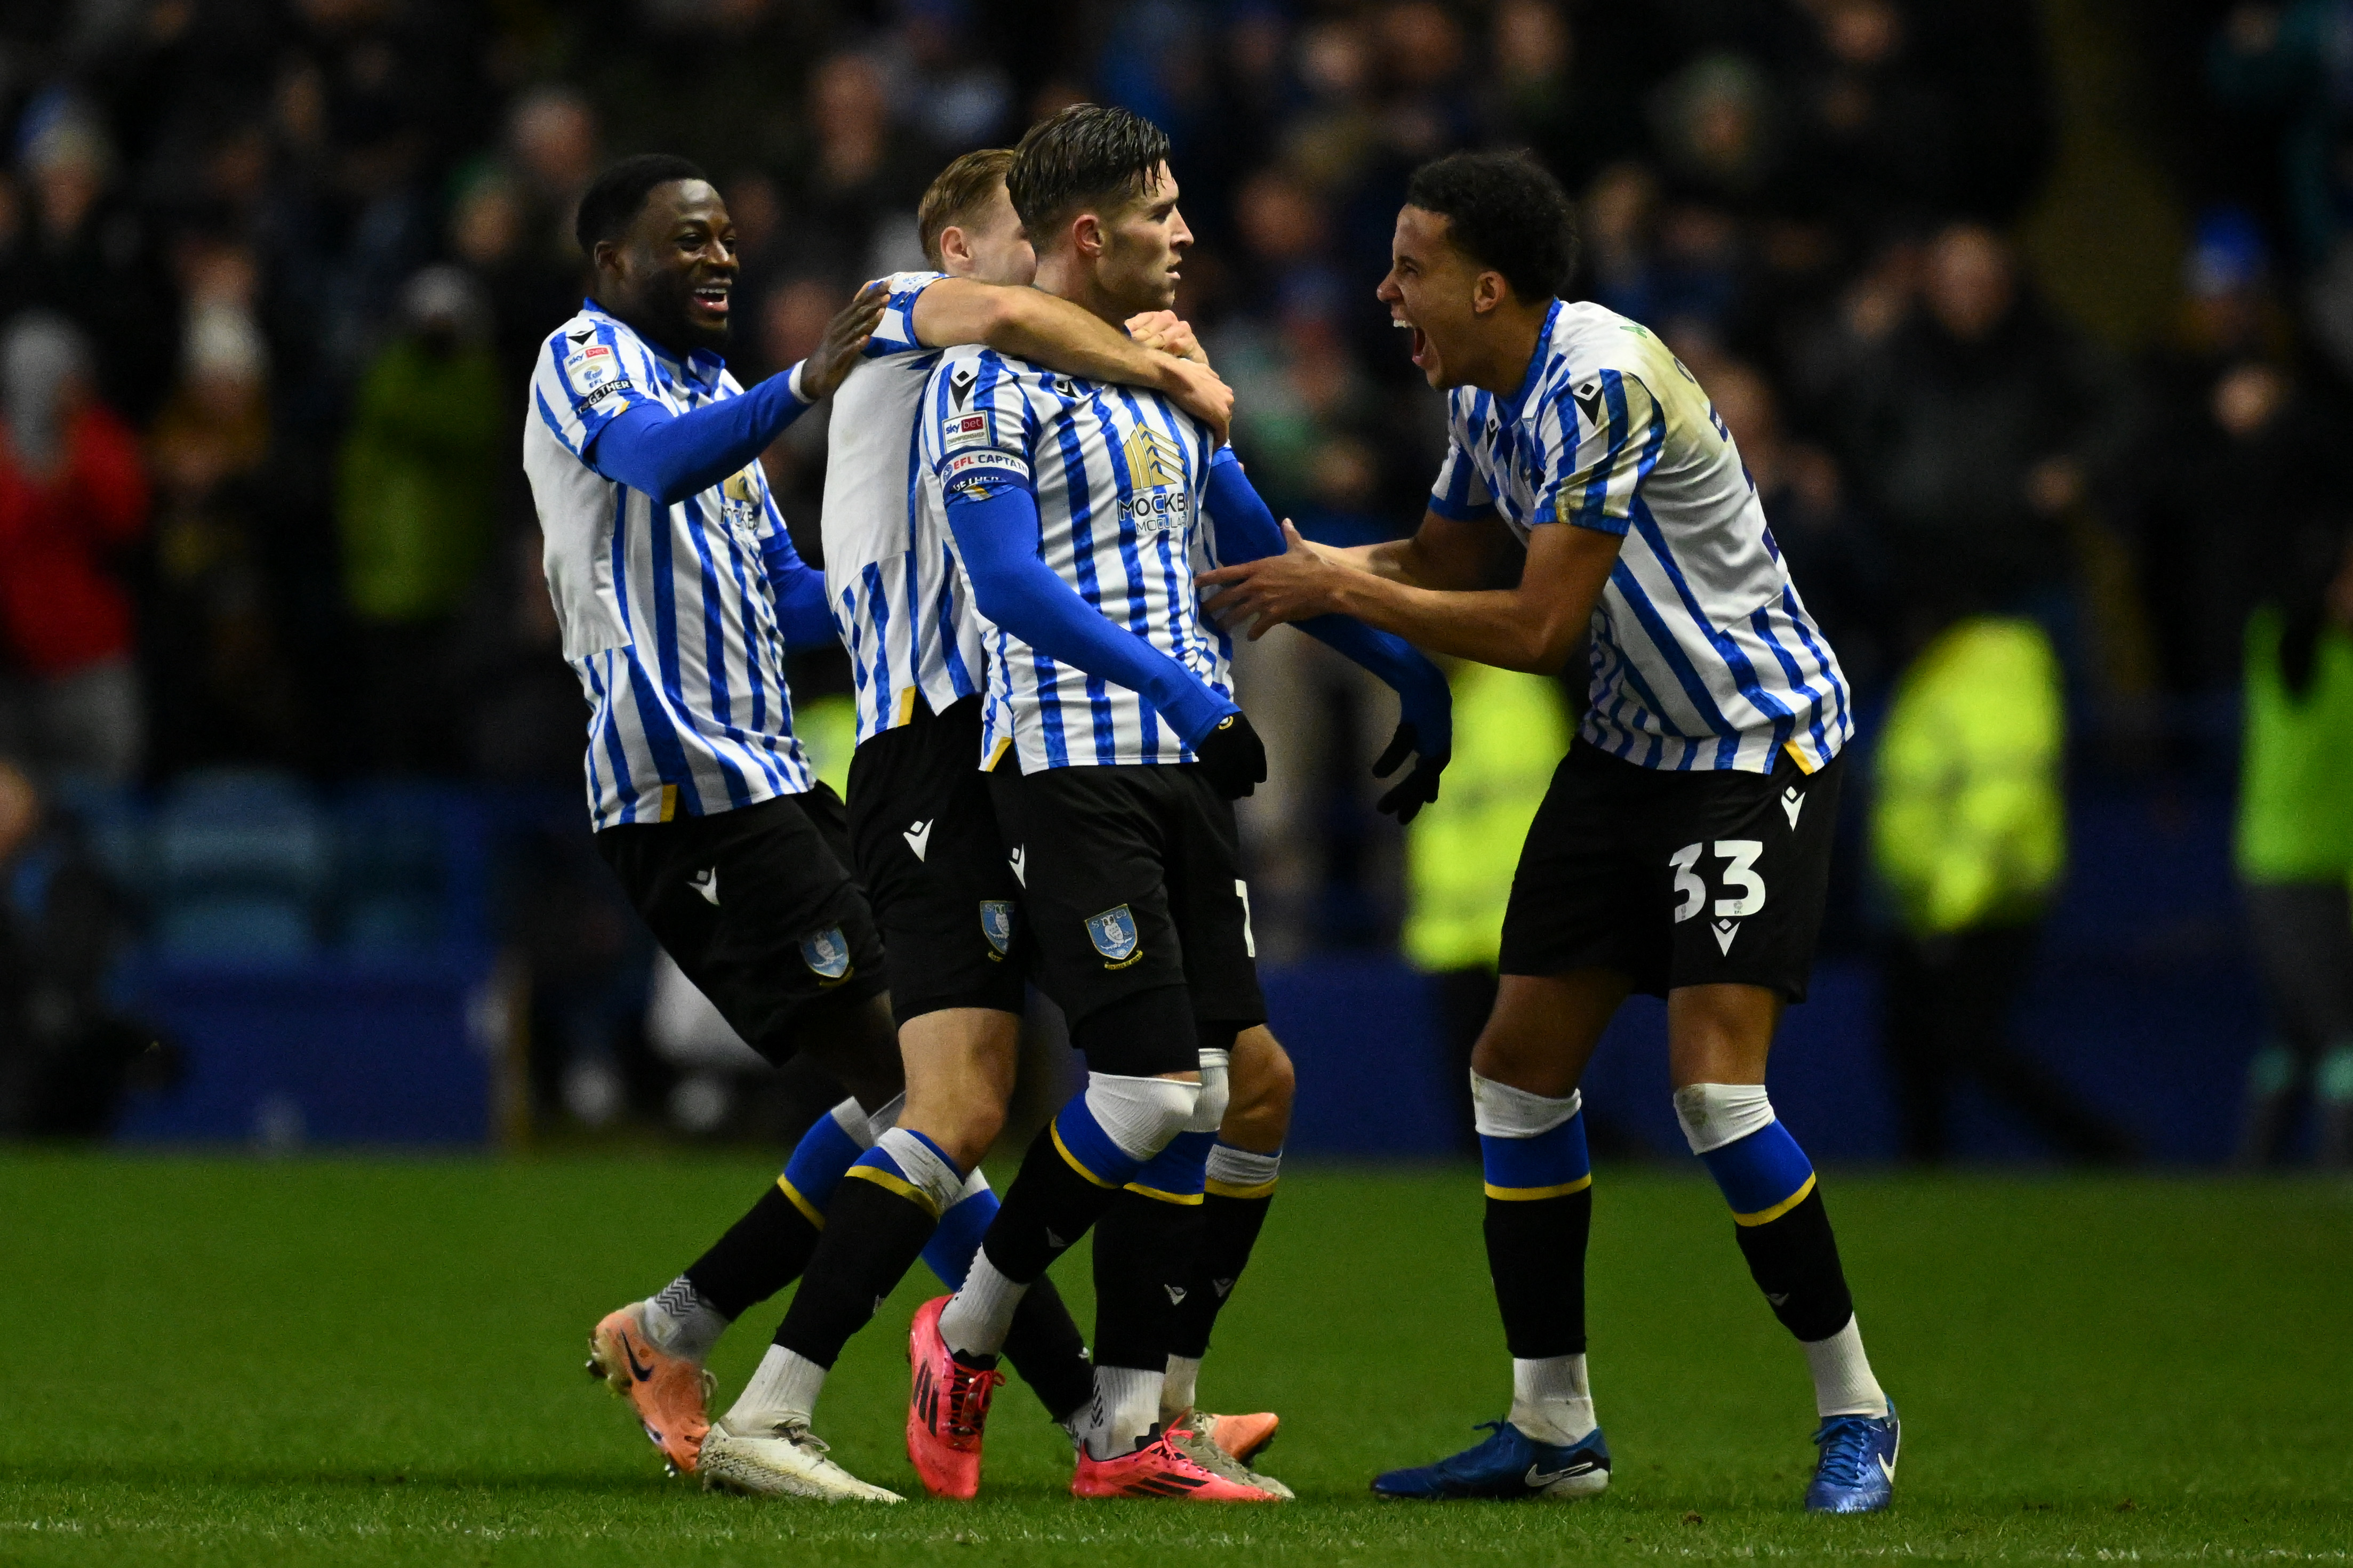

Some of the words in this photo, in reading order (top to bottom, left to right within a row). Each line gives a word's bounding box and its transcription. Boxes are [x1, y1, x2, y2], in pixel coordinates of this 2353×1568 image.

[569, 353, 584, 366] sky
[588, 348, 607, 356] bet
[589, 379, 604, 388] EFL
[946, 423, 961, 435] sky
[963, 419, 982, 429] bet
[954, 456, 974, 470] EFL
[978, 454, 1028, 475] CAPTAIN
[1119, 492, 1189, 520] MOCKB
[1669, 840, 1766, 924] 33
